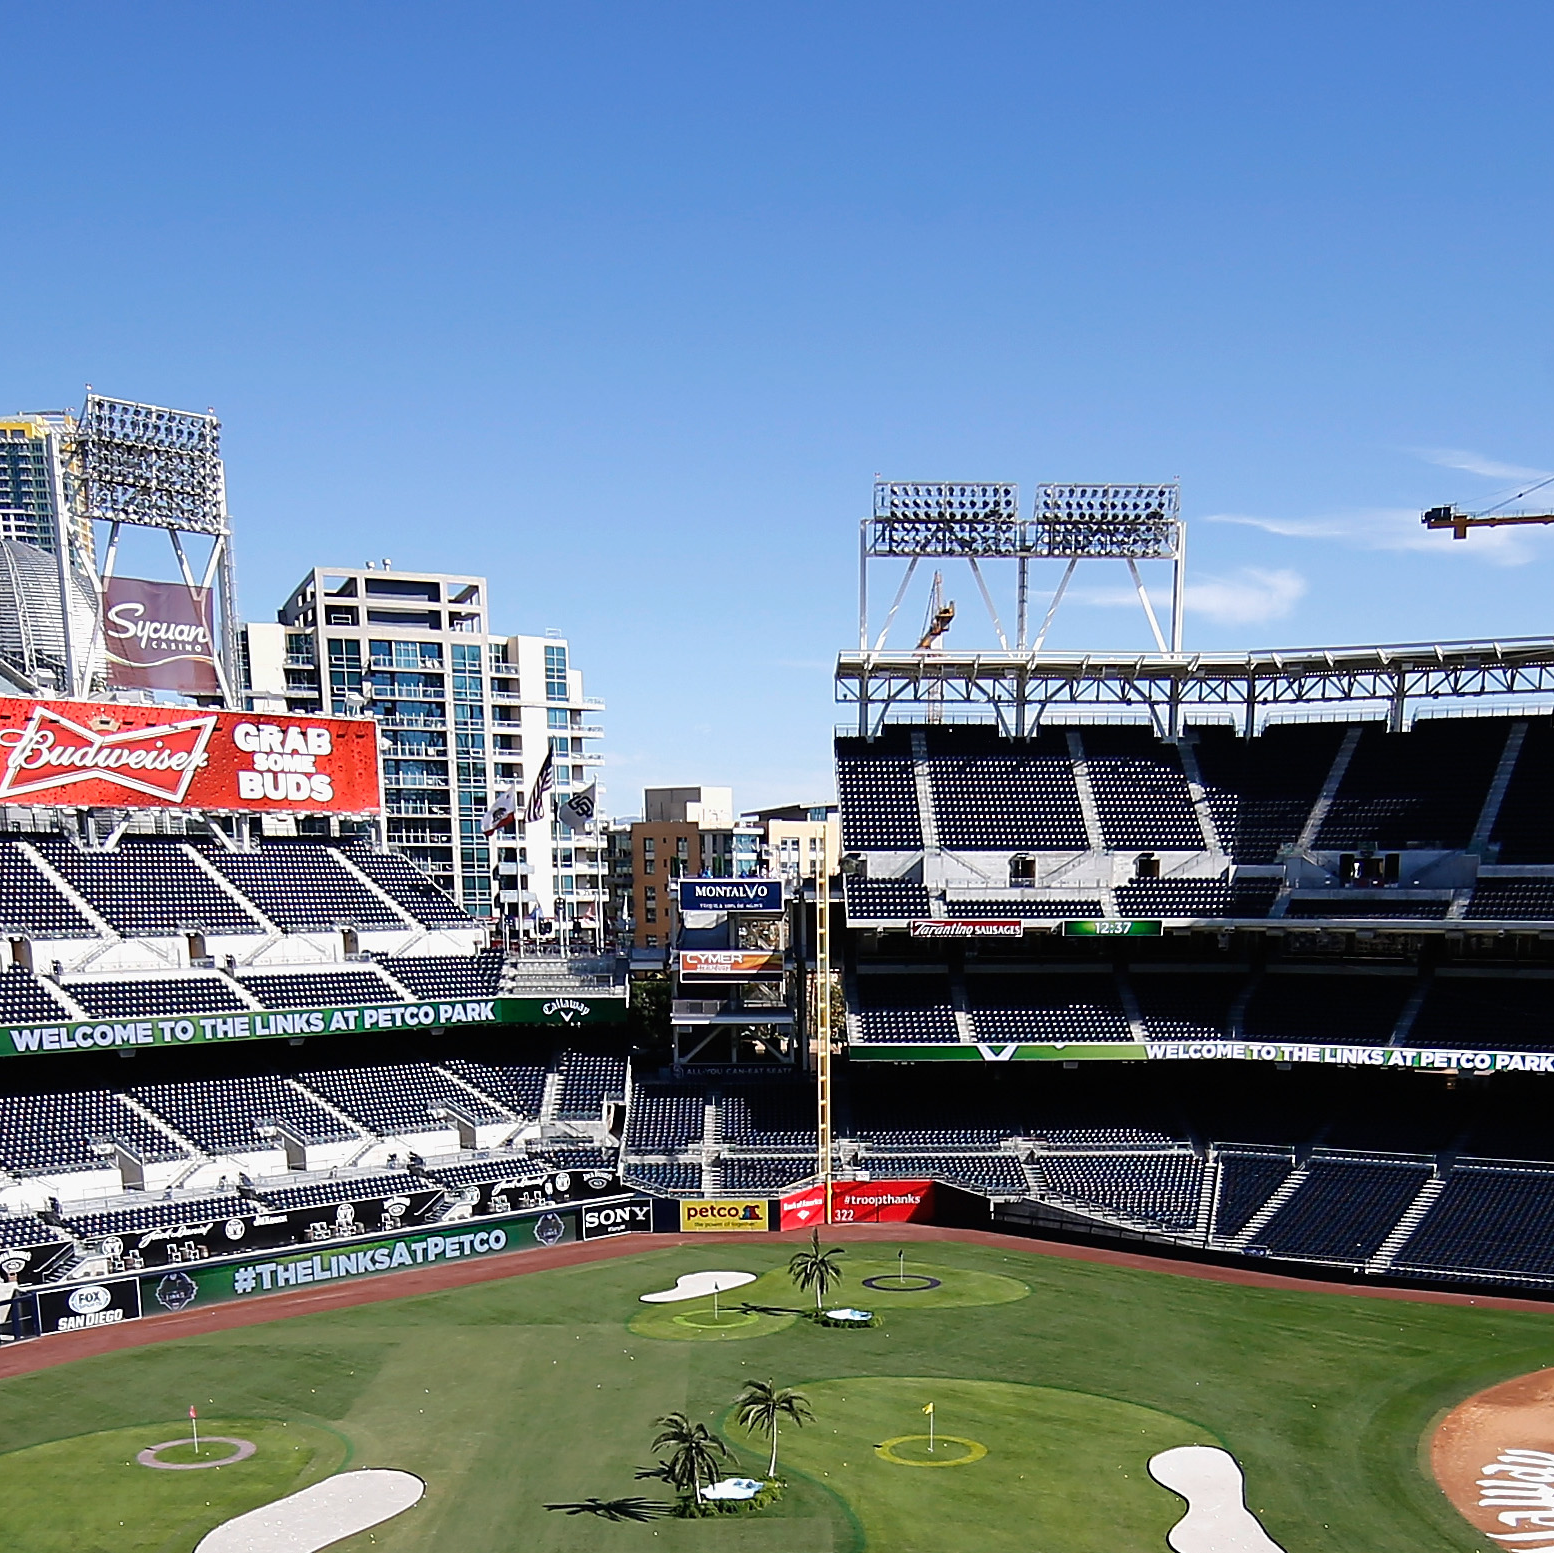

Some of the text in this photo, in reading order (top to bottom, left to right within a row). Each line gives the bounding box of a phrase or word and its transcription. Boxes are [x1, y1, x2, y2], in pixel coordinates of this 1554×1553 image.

[108, 602, 210, 649] Sycuan
[151, 640, 202, 652] CASINO
[232, 723, 333, 756] GRAB
[252, 752, 316, 773] SOME
[236, 771, 334, 801] BUDS
[695, 884, 767, 899] MONTALVO
[914, 921, 1021, 937] Tarantino SAUSAGES
[1094, 921, 1132, 934] 12:37
[686, 954, 743, 964] CYMER
[542, 999, 590, 1015] Callaway
[10, 1001, 496, 1052] WELCOME TO THE LINKS AT PETCO PARK
[1147, 1044, 1245, 1060] WELCOME
[1249, 1045, 1277, 1060] TO
[1281, 1046, 1320, 1062] THE
[1323, 1048, 1384, 1065] LINKS
[1387, 1050, 1418, 1066] AT
[1420, 1052, 1492, 1069] PETCO
[844, 1193, 921, 1206] #troopthanks
[585, 1206, 650, 1228] SONY
[687, 1204, 740, 1220] petco
[835, 1210, 854, 1221] 322
[78, 1291, 101, 1305] FOX
[58, 1308, 123, 1331] SAN DIEGO
